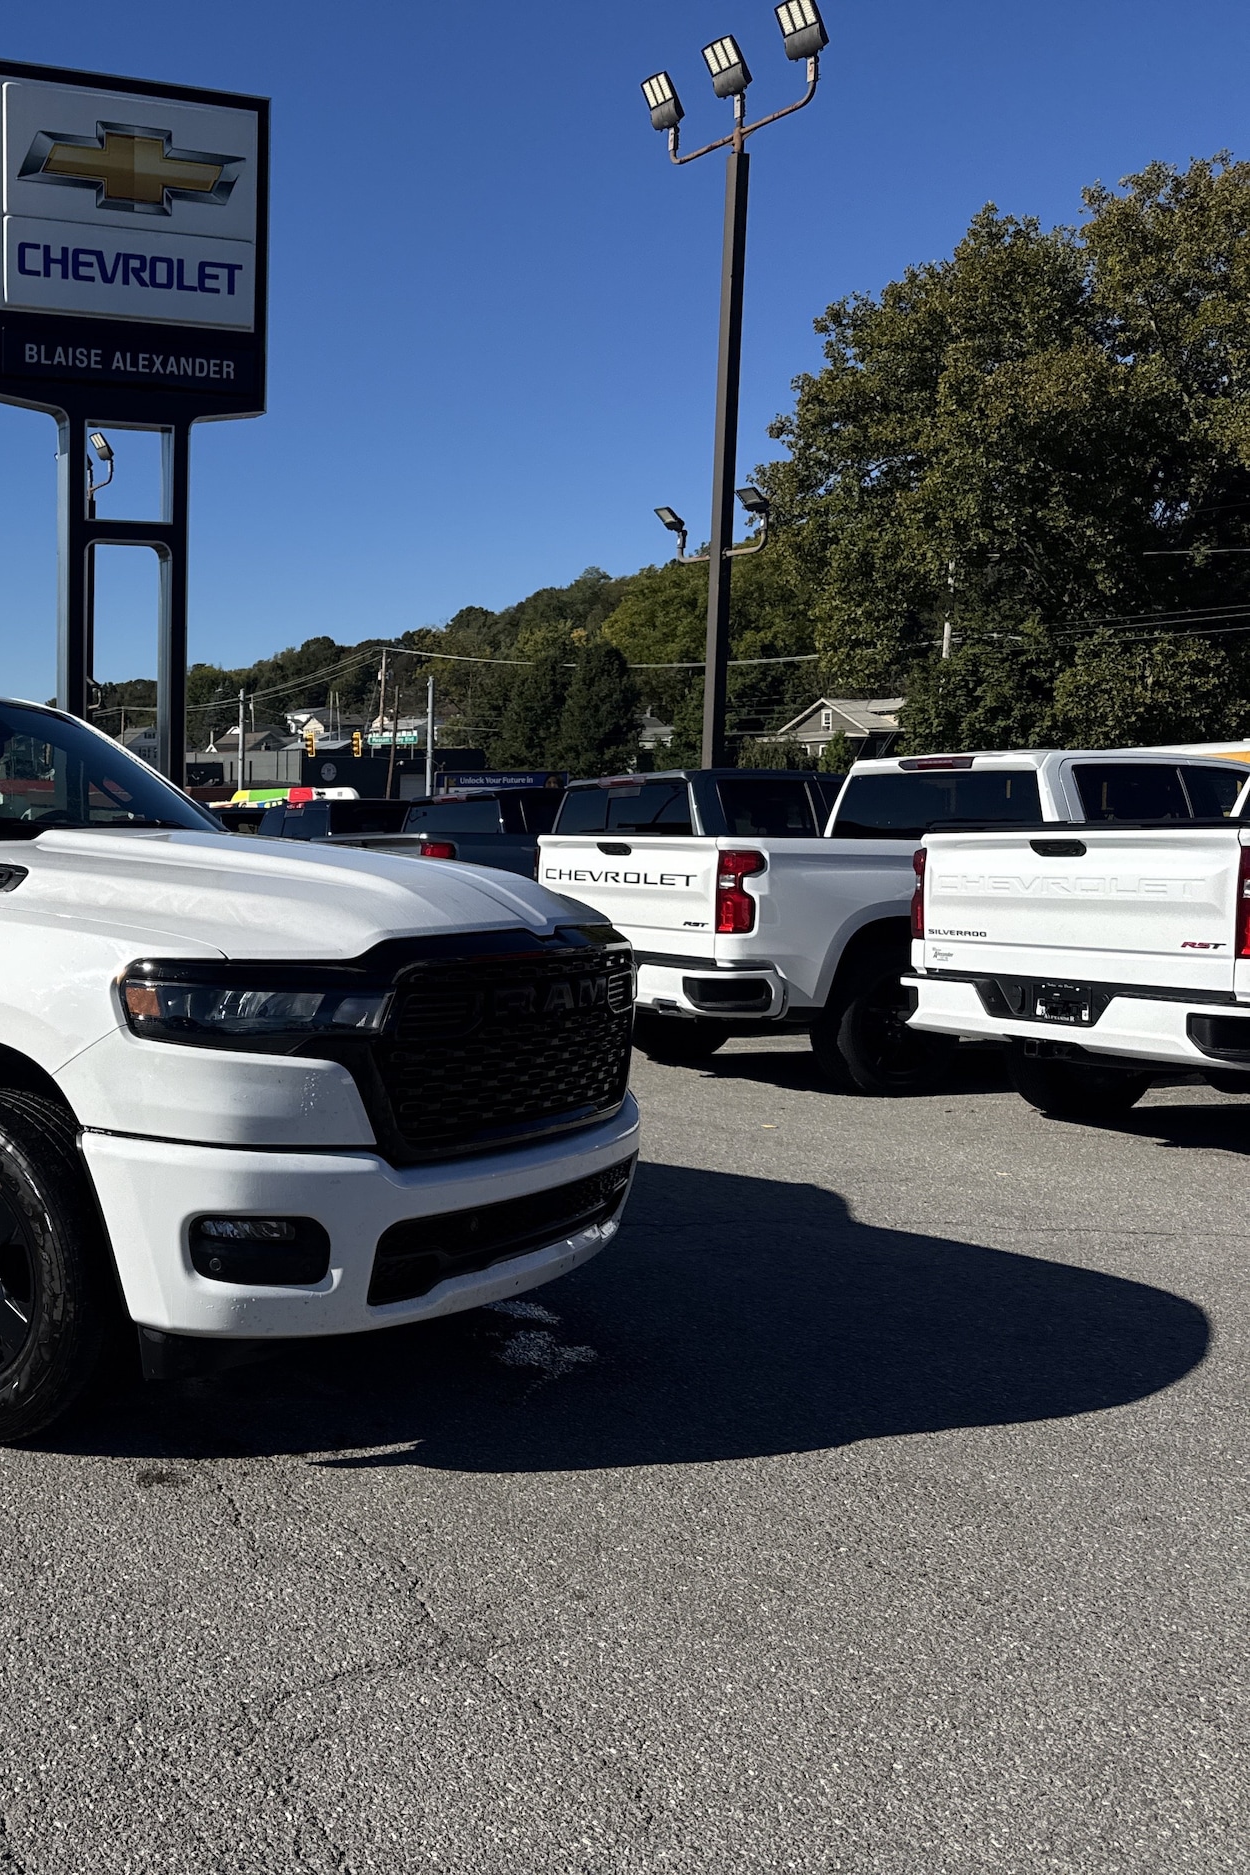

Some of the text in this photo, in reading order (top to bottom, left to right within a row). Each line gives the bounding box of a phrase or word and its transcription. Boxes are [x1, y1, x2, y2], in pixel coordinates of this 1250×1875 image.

[18, 241, 243, 295] CHEVROLET
[25, 344, 235, 379] BLAISE ALEXANDER
[545, 868, 698, 887] CHEVROLET
[937, 875, 1206, 898] CHEVROLET
[928, 929, 987, 937] SILVERADO
[1181, 941, 1227, 949] RST
[494, 976, 607, 1016] RAM
